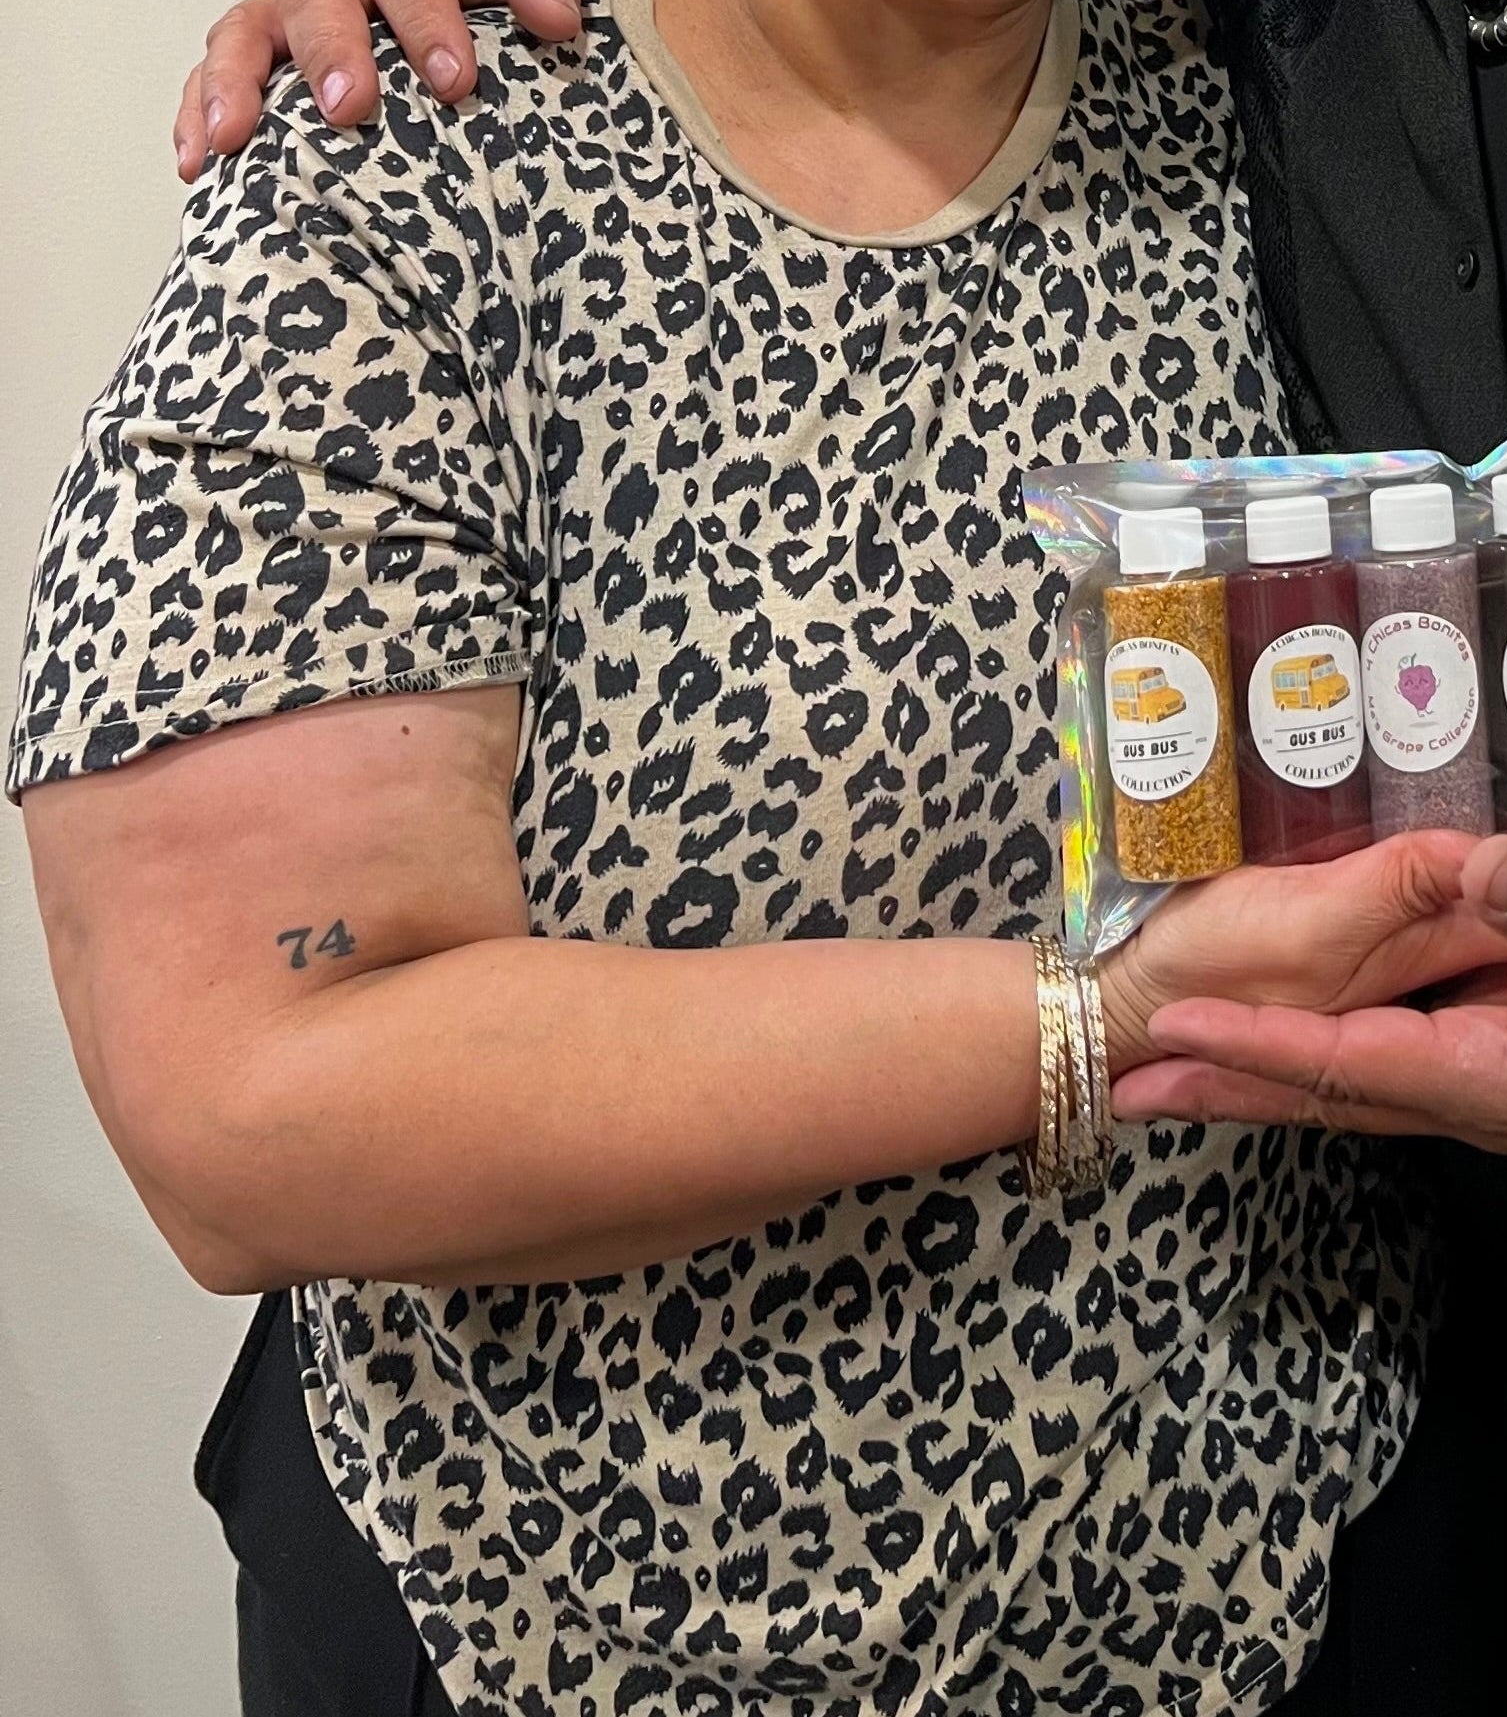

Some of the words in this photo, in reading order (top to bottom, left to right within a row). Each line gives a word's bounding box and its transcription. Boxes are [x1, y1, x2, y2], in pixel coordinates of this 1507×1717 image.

[1368, 619, 1412, 654] Chicas
[1418, 616, 1469, 662] Bonitas
[1366, 658, 1374, 671] 4
[1382, 730, 1424, 753] Grape
[1428, 687, 1476, 751] Collection
[1323, 724, 1346, 743] BUS
[1150, 740, 1178, 756] BUS
[1285, 754, 1355, 780] COLLECTION
[1120, 768, 1192, 793] COLLECTION
[277, 918, 356, 970] 74
